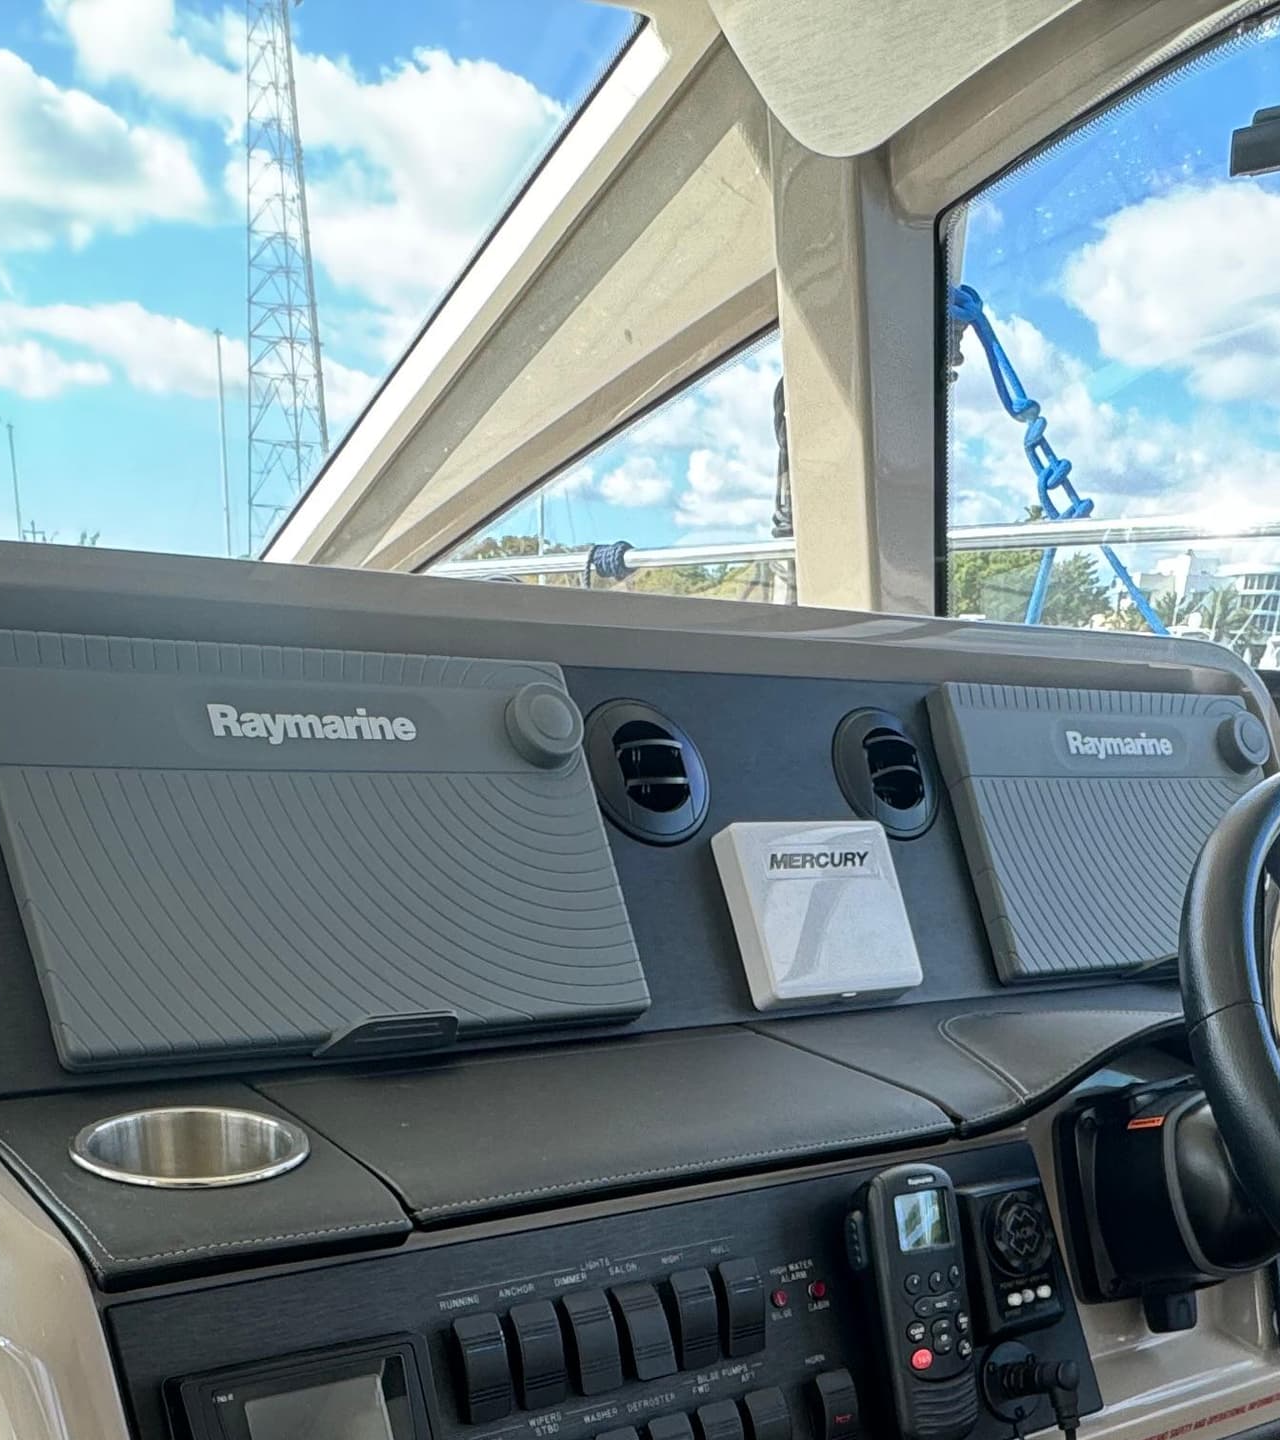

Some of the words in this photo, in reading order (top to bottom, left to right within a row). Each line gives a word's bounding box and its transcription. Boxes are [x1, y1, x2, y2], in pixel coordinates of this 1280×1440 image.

[206, 703, 418, 745] Raymarine
[1065, 730, 1173, 759] Raymarine
[769, 851, 869, 871] MERCURY
[580, 1258, 611, 1273] LIGHTS
[609, 1263, 638, 1276] SALON
[788, 1259, 814, 1271] WATER
[553, 1272, 587, 1287] DIMMER
[781, 1270, 808, 1283] ALARM
[498, 1283, 535, 1298] ANCHOR
[439, 1294, 480, 1311] RUNNING
[627, 1392, 676, 1414] DEFROSTER
[528, 1412, 563, 1428] WIPERS
[583, 1407, 619, 1424] WASHER
[535, 1424, 560, 1437] STBD
